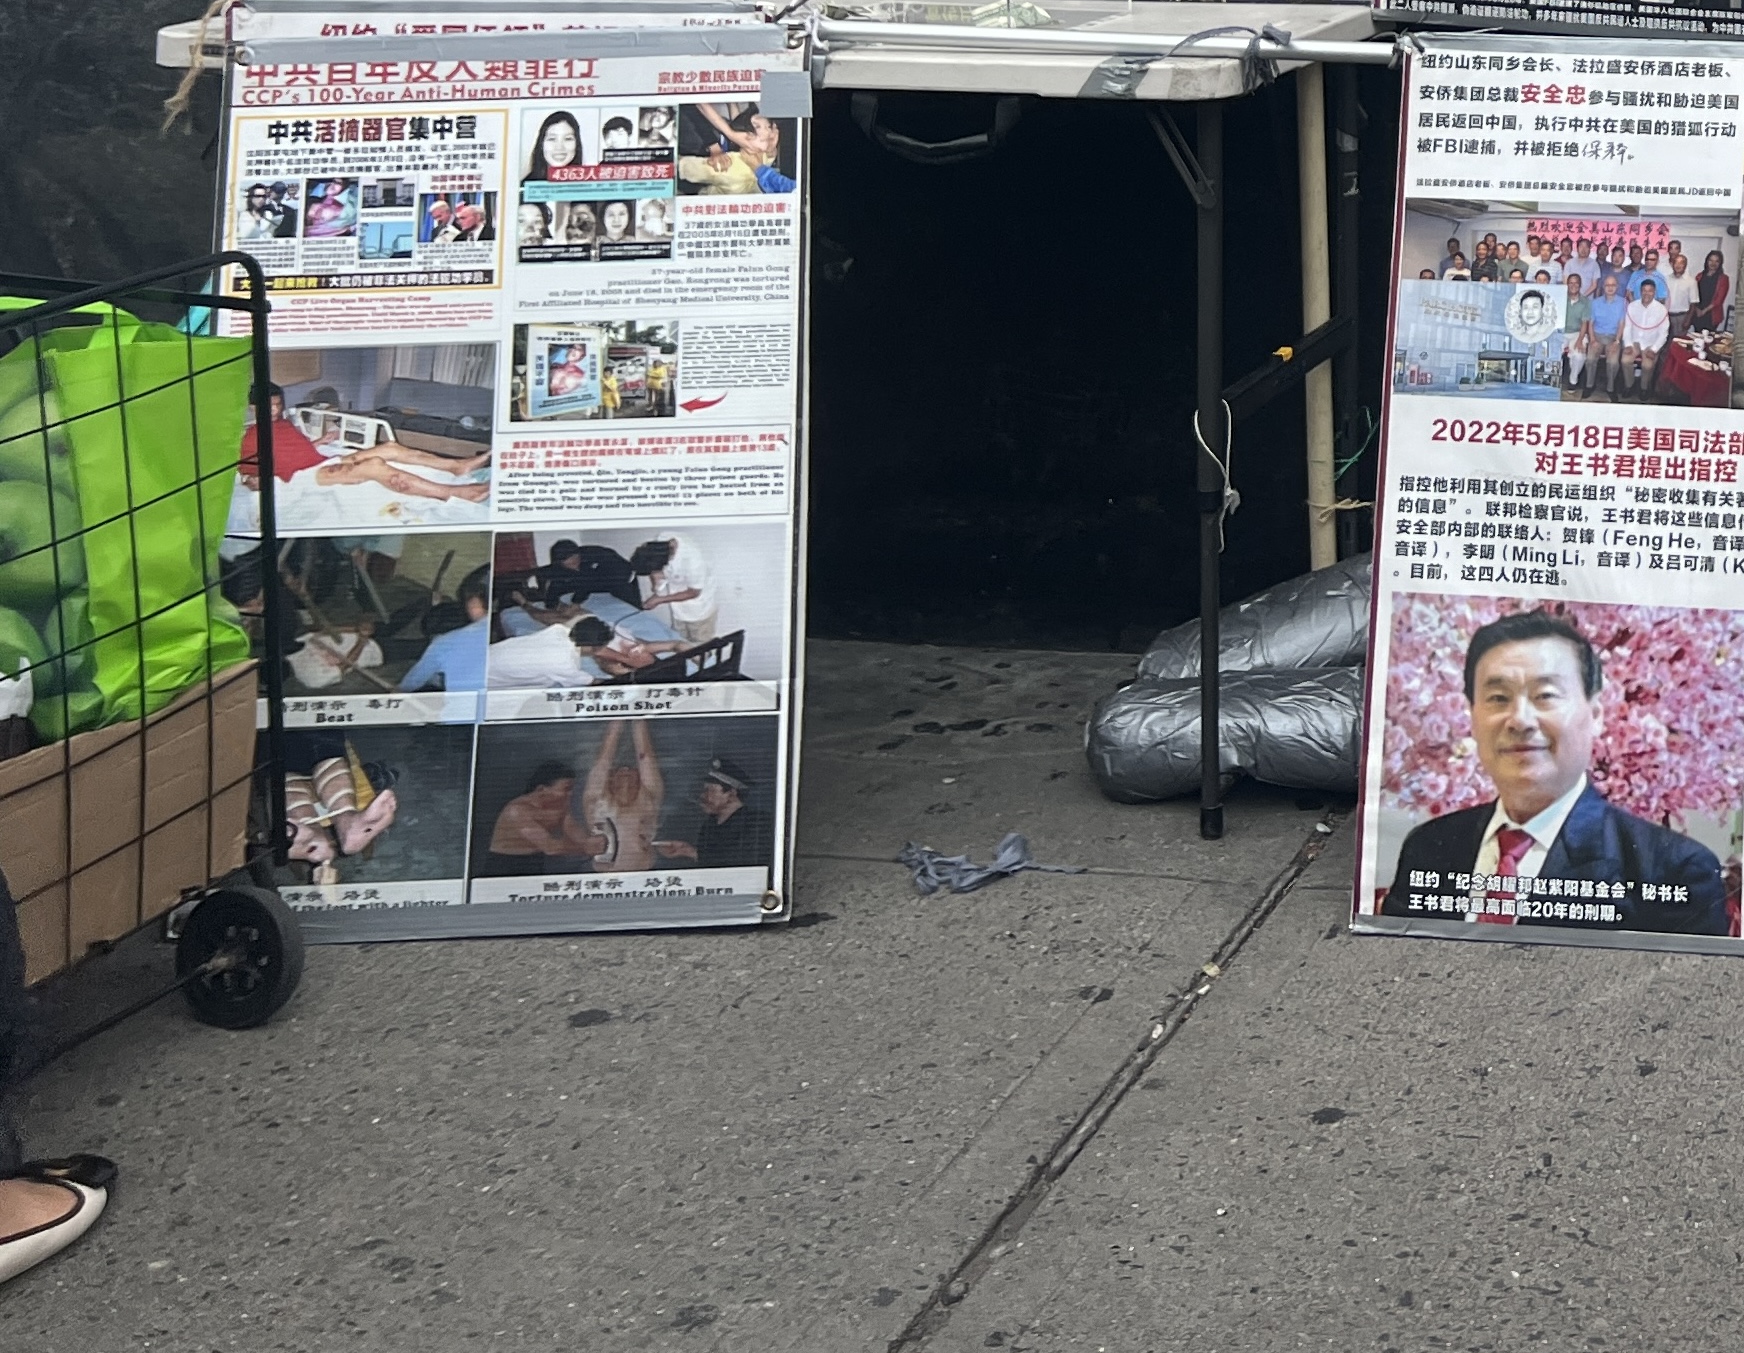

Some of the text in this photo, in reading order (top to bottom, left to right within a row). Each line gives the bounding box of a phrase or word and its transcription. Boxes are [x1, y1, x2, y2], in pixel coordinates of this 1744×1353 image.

[308, 87, 395, 102] 100-Year
[404, 85, 520, 100] Anti-Human
[528, 82, 595, 97] Crimes
[268, 115, 477, 144] 中共活摘器官集中营
[1534, 452, 1739, 484] 对王书君提出指控
[575, 700, 672, 713] Poison Shot
[316, 713, 353, 723] Beat
